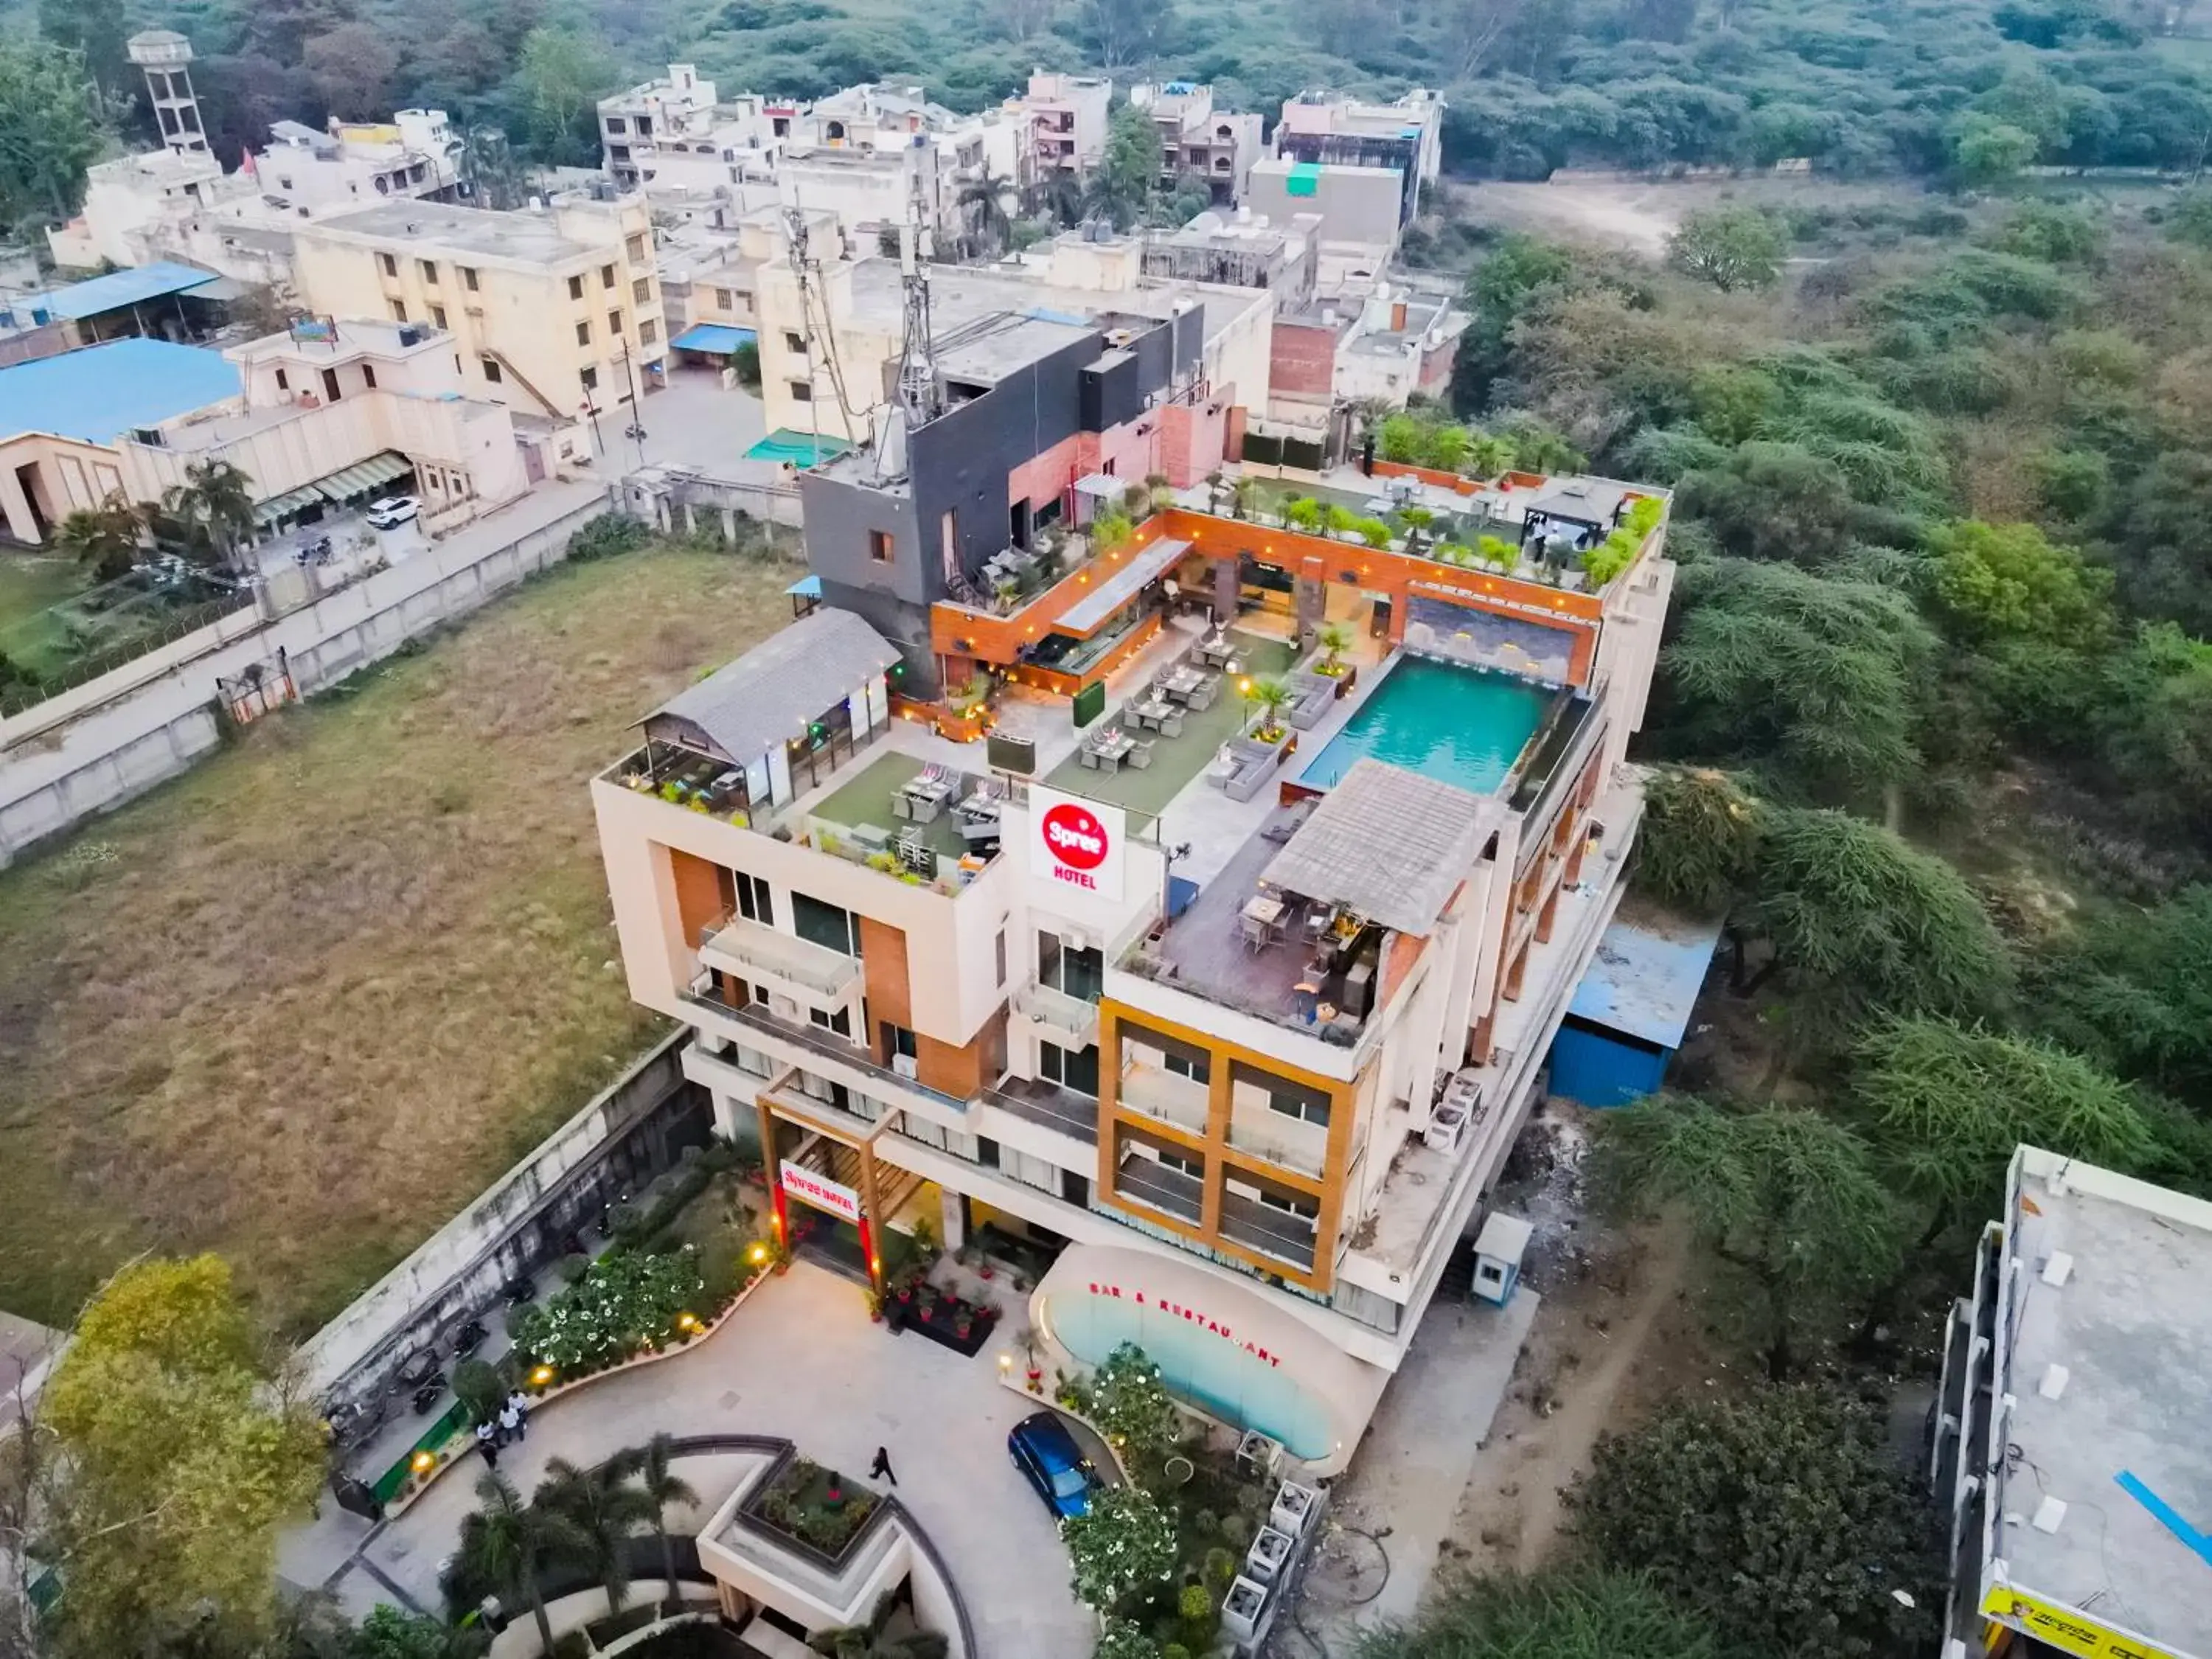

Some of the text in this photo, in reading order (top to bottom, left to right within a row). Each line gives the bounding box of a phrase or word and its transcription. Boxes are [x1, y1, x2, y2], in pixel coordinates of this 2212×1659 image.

[1049, 821, 1102, 854] Spree
[1054, 866, 1096, 890] HOTEL
[1089, 1283, 1121, 1298] BAR
